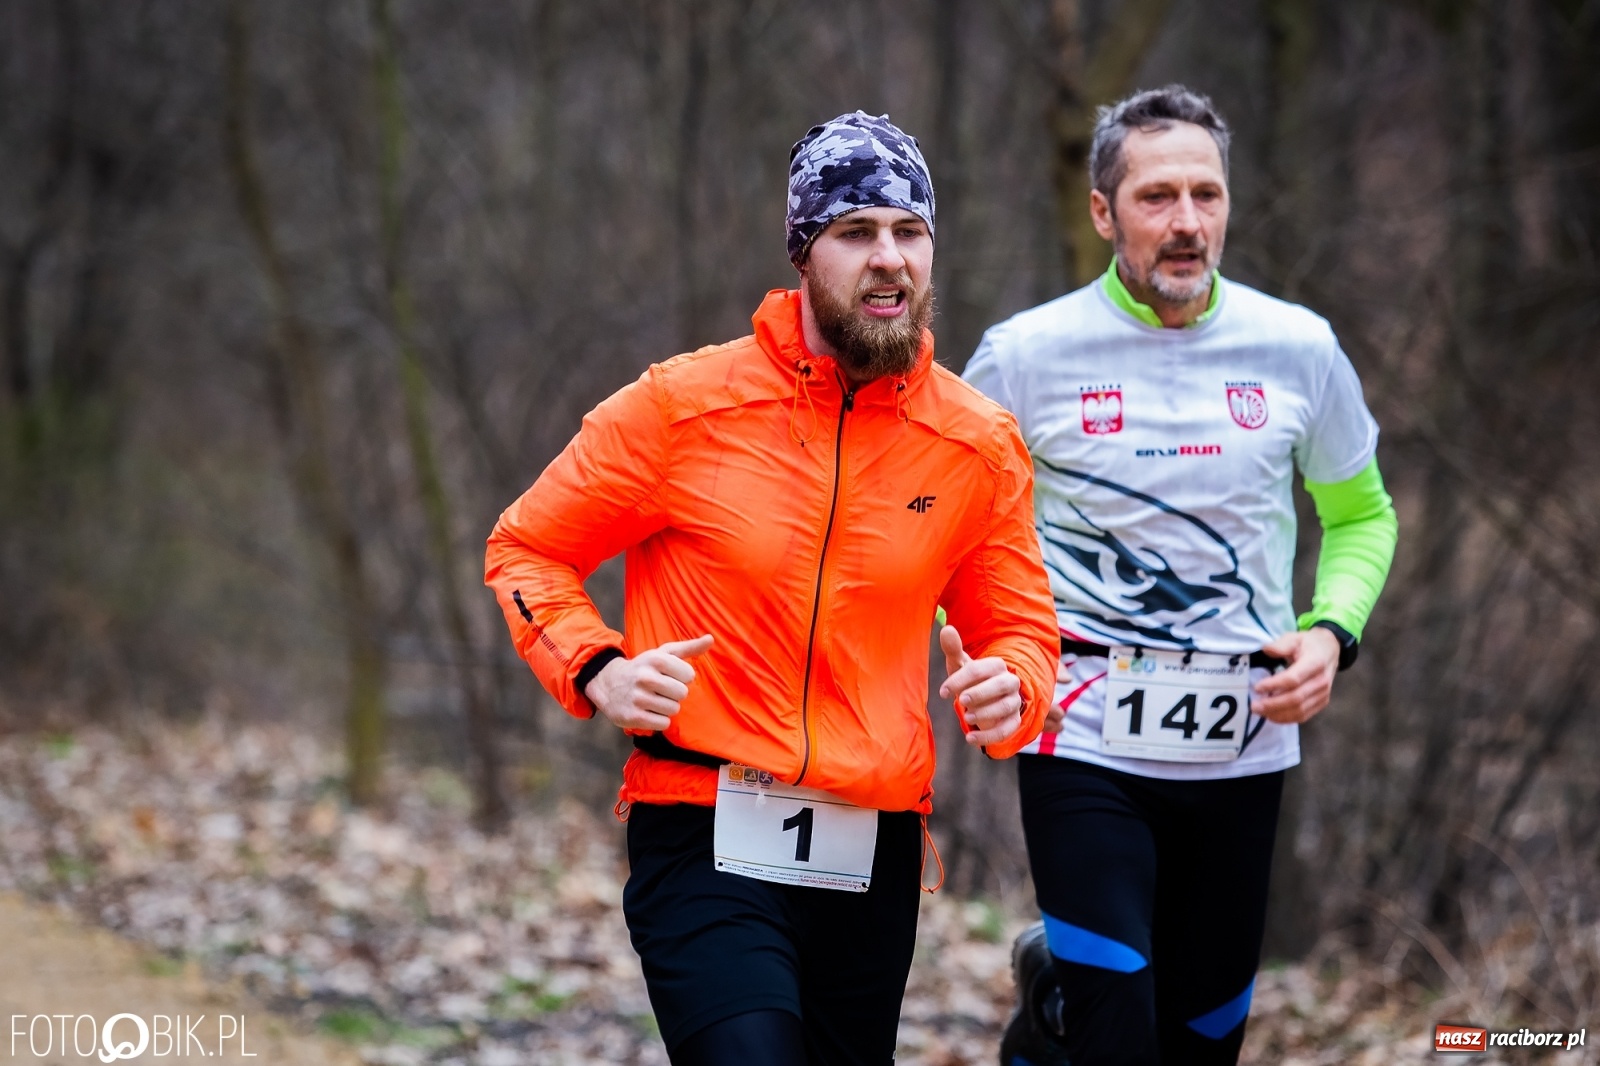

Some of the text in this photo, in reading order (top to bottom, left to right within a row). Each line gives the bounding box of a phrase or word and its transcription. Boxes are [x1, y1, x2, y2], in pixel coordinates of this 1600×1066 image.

[906, 495, 937, 514] 4F
[1116, 688, 1238, 741] 142
[782, 806, 814, 863] 1
